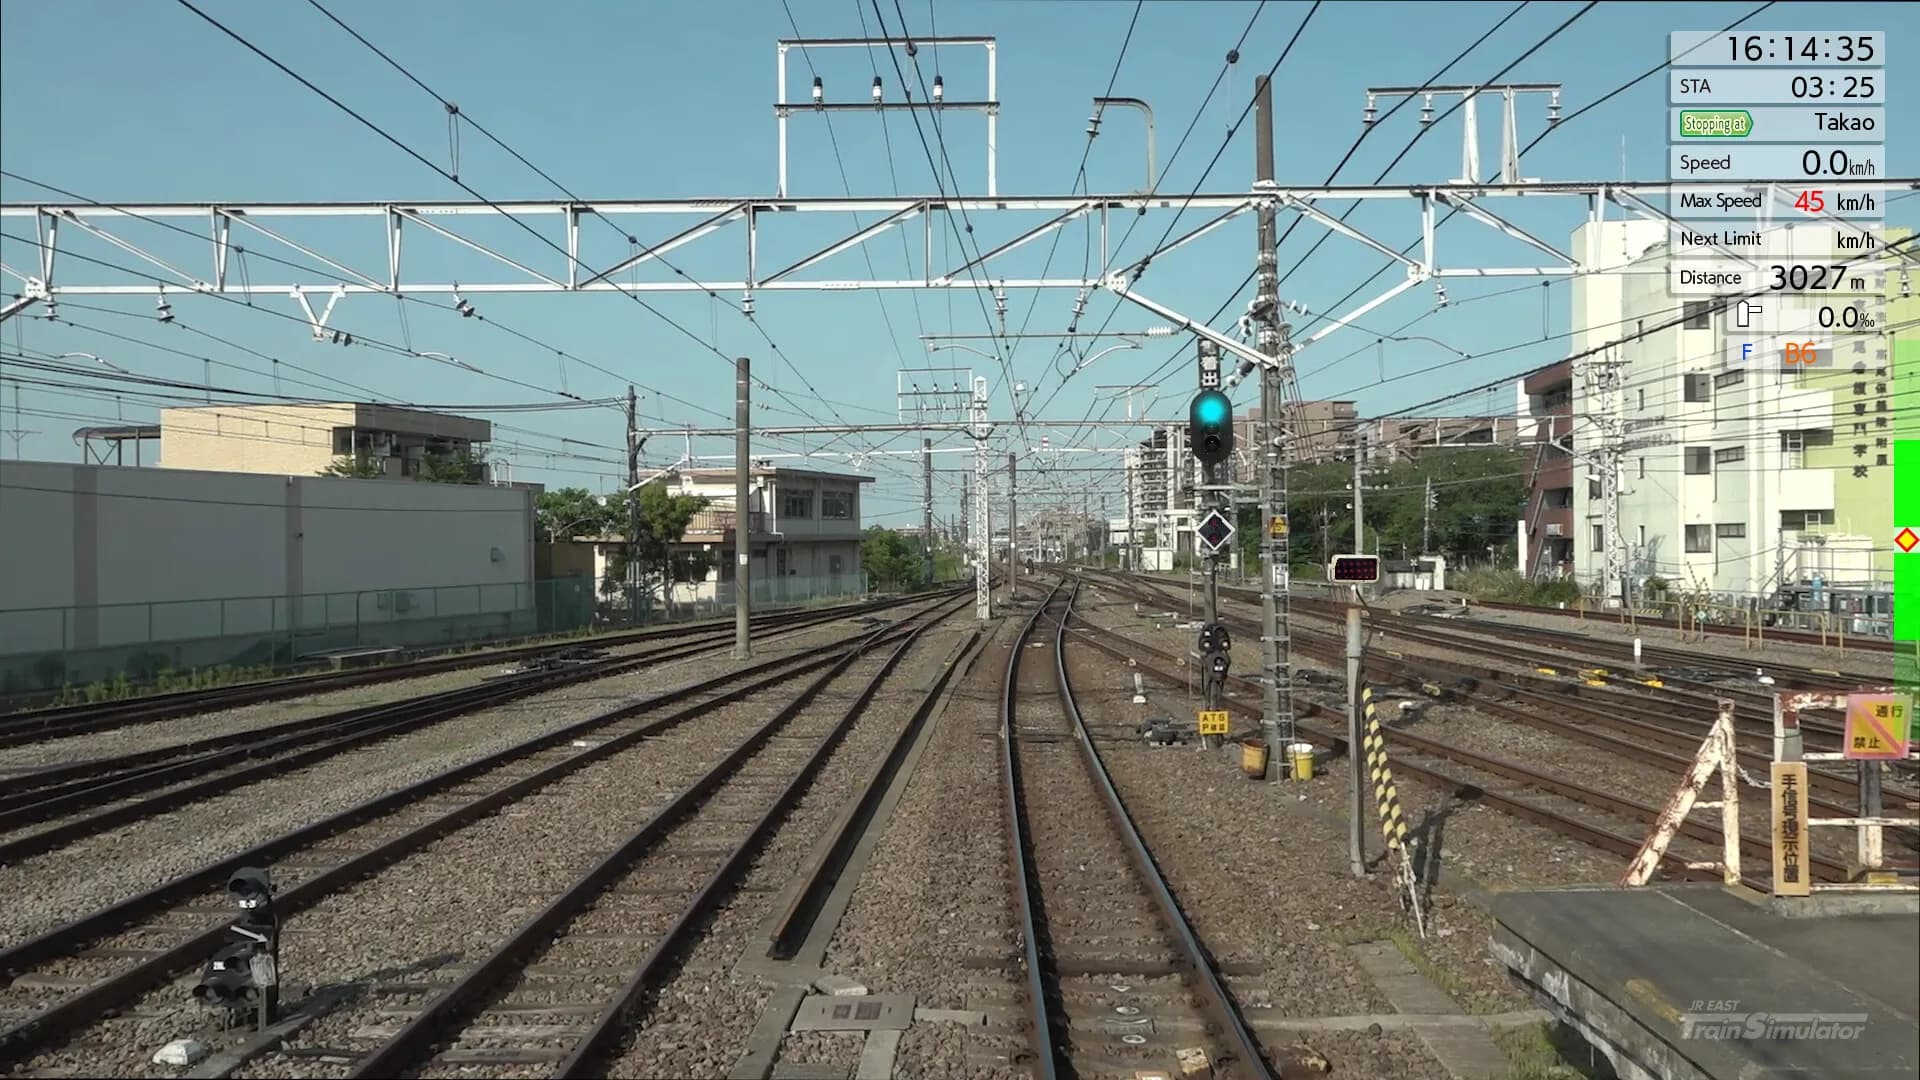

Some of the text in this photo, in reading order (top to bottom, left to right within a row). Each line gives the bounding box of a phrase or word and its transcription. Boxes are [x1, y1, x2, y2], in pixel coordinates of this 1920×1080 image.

[1876, 704, 1904, 718] 通行
[1853, 736, 1880, 749] 禁止
[1781, 773, 1799, 883] 手信号現示位置
